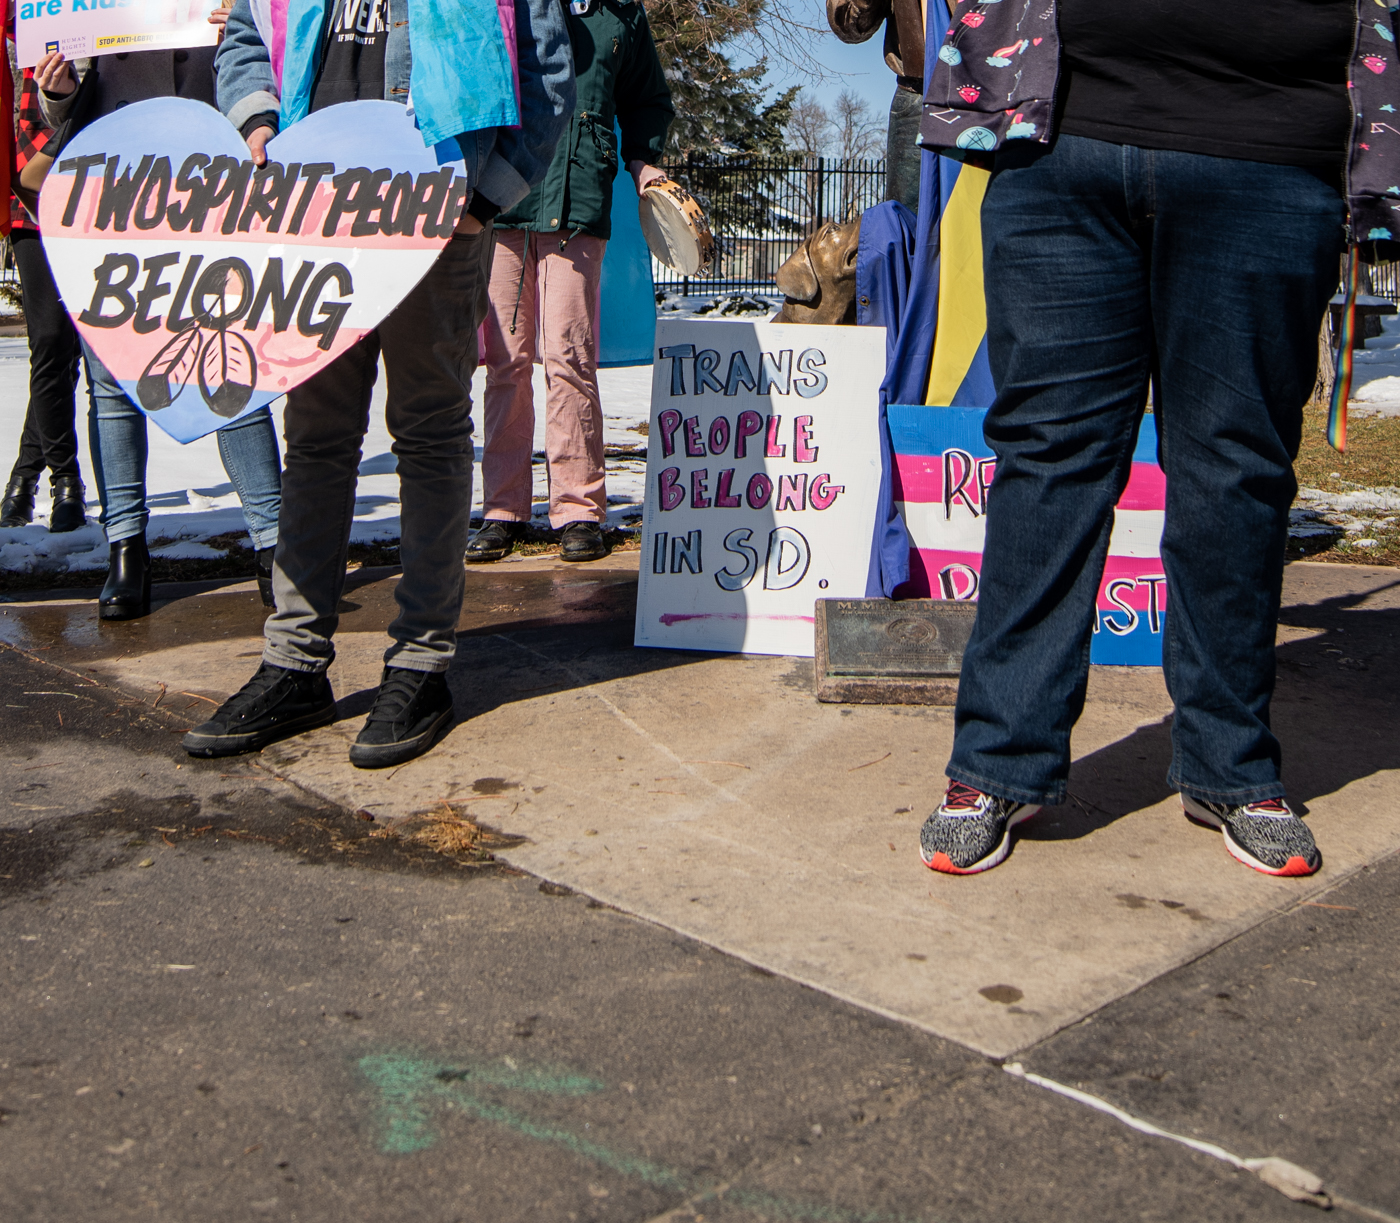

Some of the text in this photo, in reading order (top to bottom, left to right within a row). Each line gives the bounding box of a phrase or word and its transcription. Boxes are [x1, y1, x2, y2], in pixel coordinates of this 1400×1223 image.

[99, 38, 116, 46] STOP
[78, 251, 353, 350] BELONG
[659, 343, 828, 399] TRANS
[658, 409, 819, 463] PEOPLE
[658, 466, 845, 512] BELONG
[652, 529, 703, 575] IN
